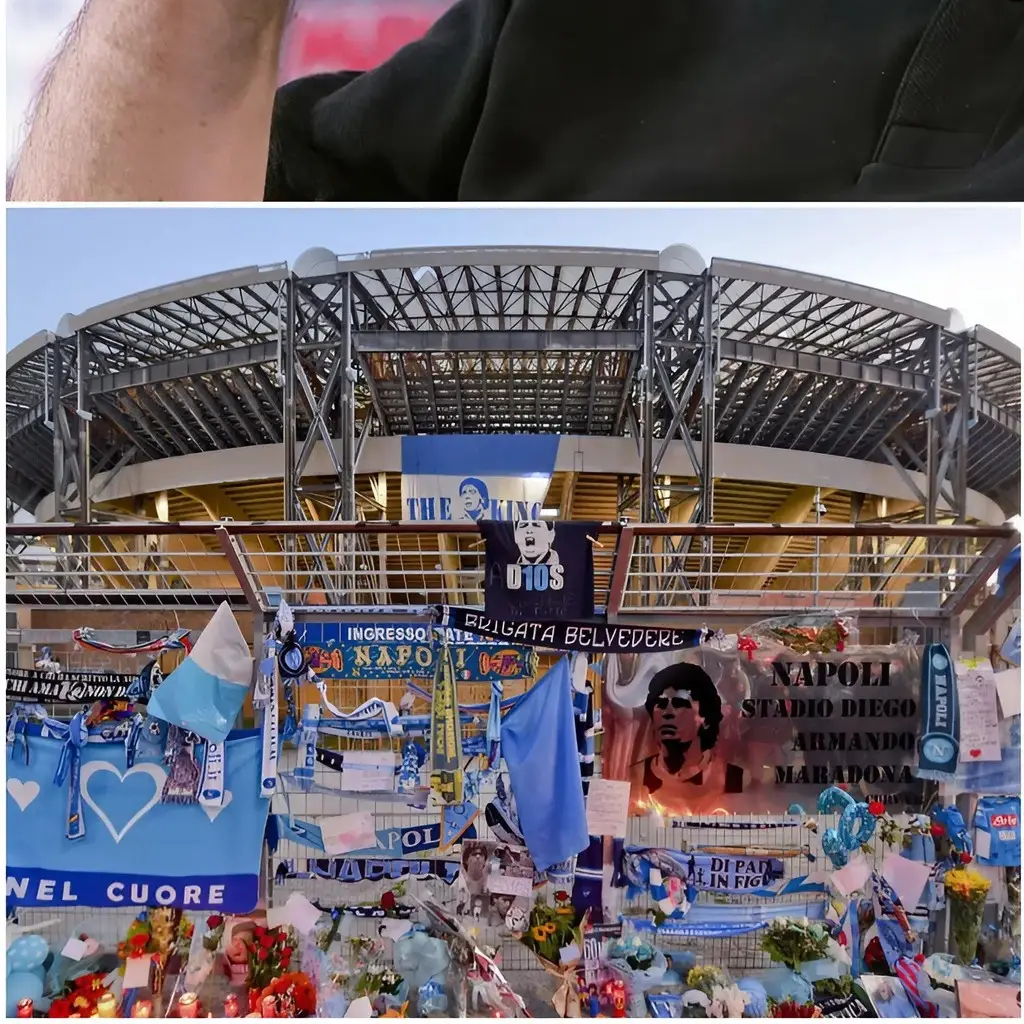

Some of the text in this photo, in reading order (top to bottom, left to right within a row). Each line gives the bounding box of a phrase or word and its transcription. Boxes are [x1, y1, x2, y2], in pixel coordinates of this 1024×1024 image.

[407, 497, 452, 520] THE
[507, 564, 564, 591] D10S
[348, 627, 426, 642] INGRESSO
[465, 614, 684, 647] BRIGATA BELVEDERE
[353, 645, 467, 668] NAPOI
[771, 661, 891, 687] NAPOLI
[741, 698, 917, 719] STADIO DIEGO
[792, 732, 917, 751] ARMANDO
[775, 764, 913, 785] MARADONA
[711, 857, 730, 872] DI
[6, 877, 225, 905] NEL CUORE
[710, 874, 729, 889] IN
